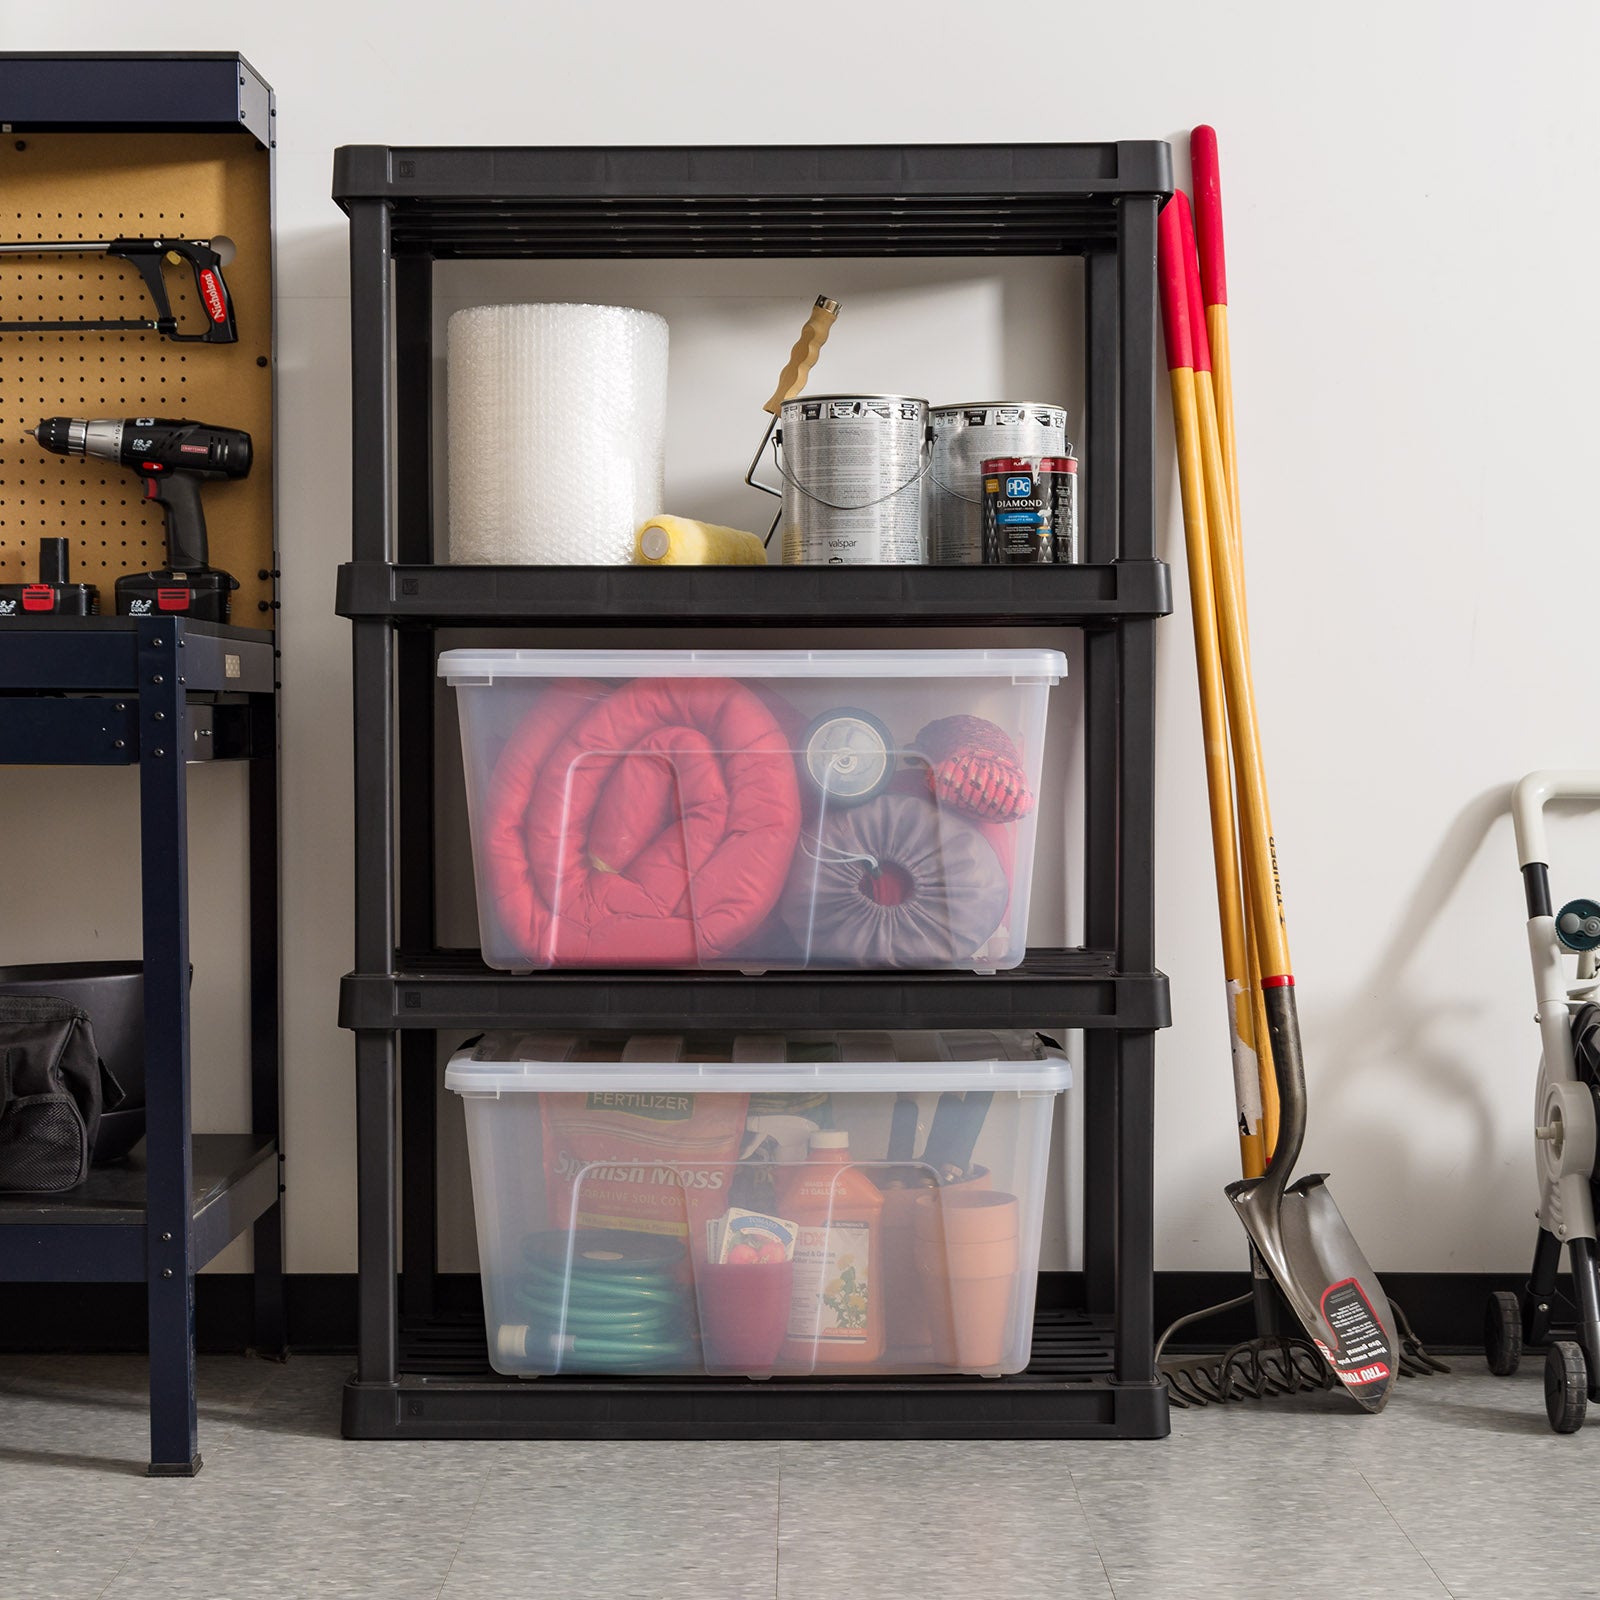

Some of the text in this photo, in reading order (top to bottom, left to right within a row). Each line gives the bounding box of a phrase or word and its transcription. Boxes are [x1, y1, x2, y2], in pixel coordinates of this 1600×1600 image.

[205, 273, 225, 320] Nicholson
[132, 438, 153, 448] 19.2
[1007, 479, 1030, 496] PPG
[996, 499, 1043, 509] DIAMOND
[828, 538, 857, 549] valspar
[130, 599, 152, 609] 19.2
[592, 1091, 689, 1111] FERTILIZER
[650, 1157, 724, 1190] Moss
[632, 1193, 657, 1206] SOIL
[661, 1195, 699, 1207] COVR
[749, 1217, 778, 1230] TOMATO
[1368, 1340, 1382, 1348] Use
[1368, 1346, 1388, 1358] Home
[1361, 1366, 1387, 1382] TRU
